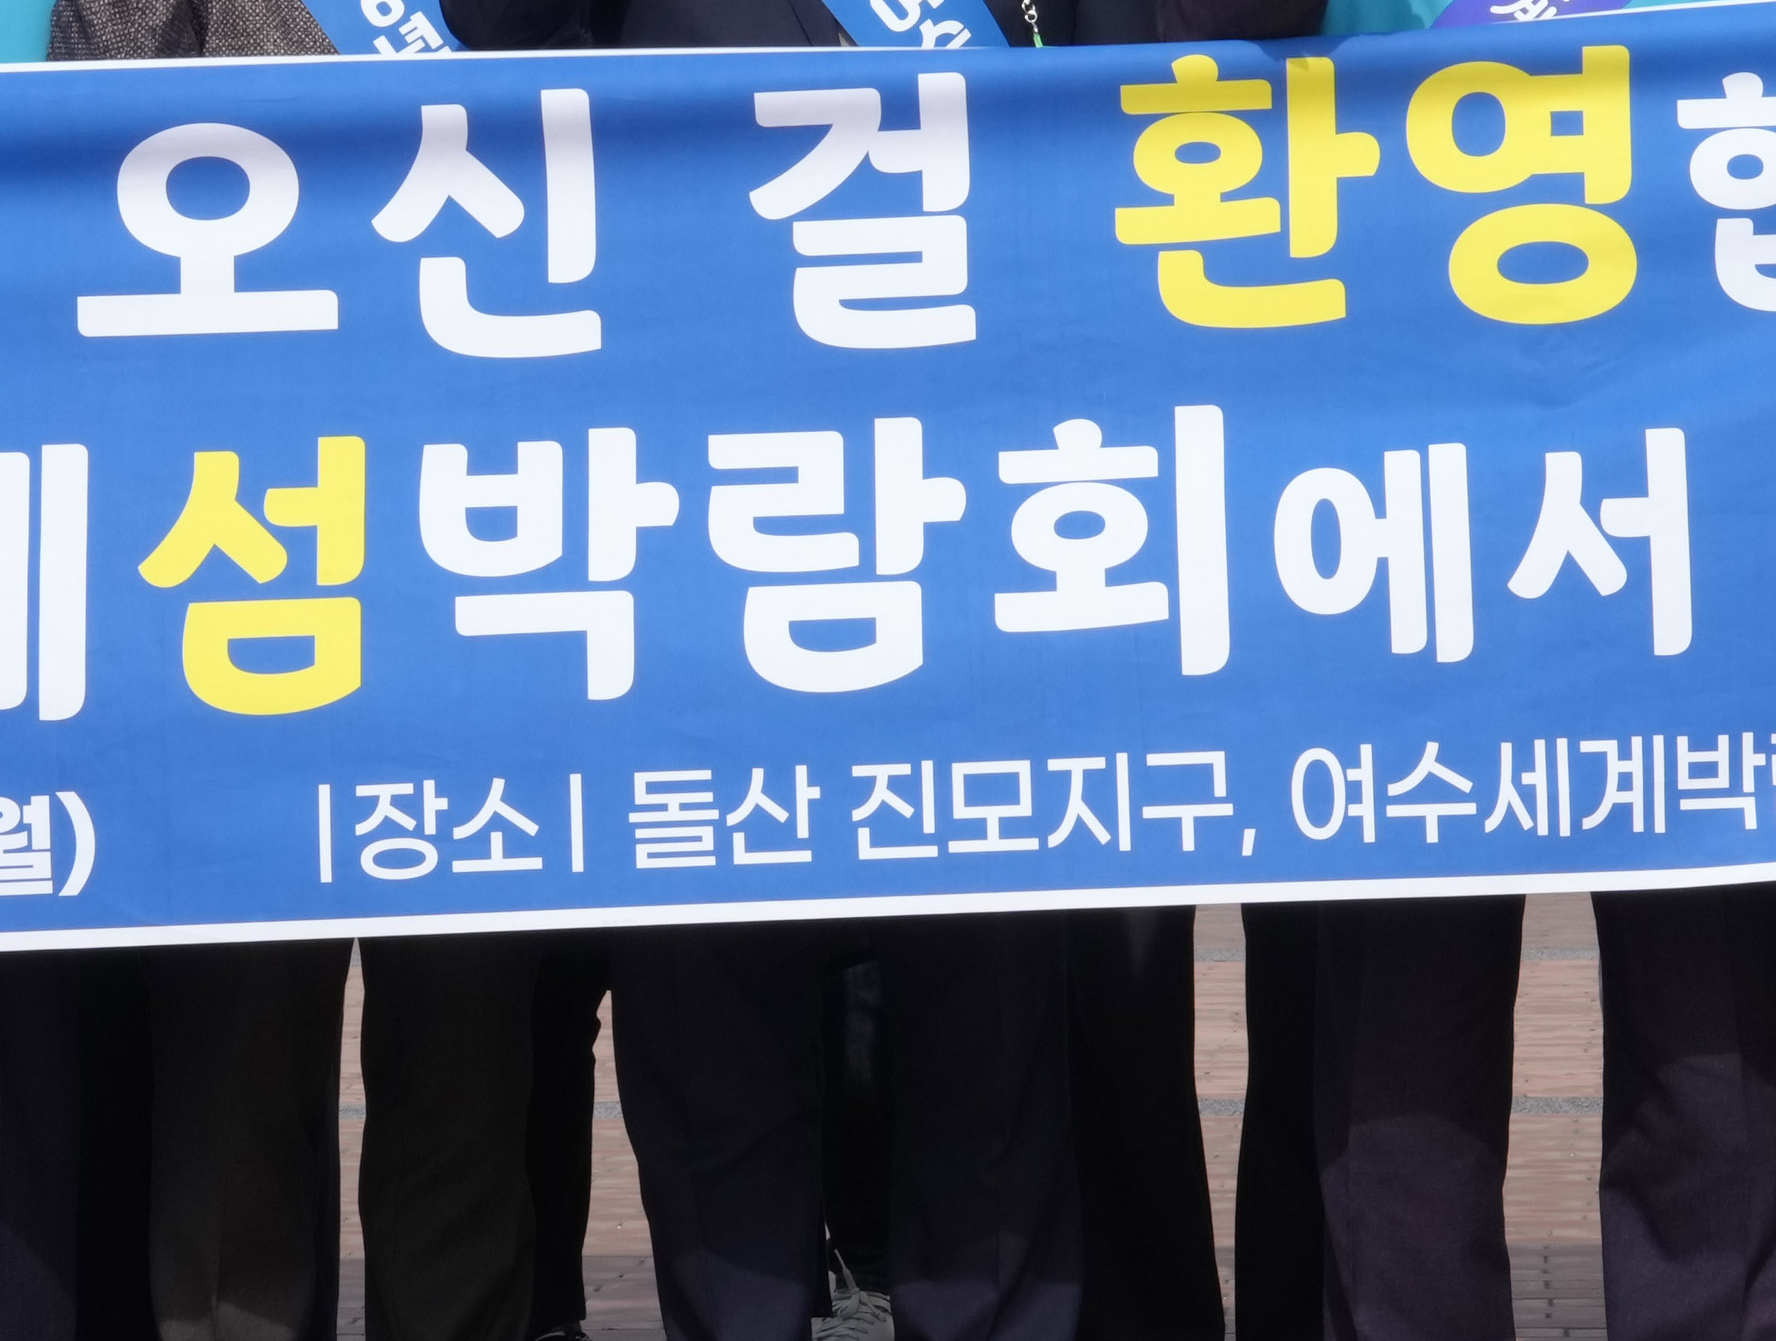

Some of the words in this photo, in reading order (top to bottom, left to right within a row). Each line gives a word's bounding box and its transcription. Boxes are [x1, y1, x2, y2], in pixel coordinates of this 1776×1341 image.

[77, 87, 601, 359] 오신
[748, 71, 977, 351] 걸
[629, 765, 820, 868] 돌산
[852, 751, 1256, 861] 진모지구,
